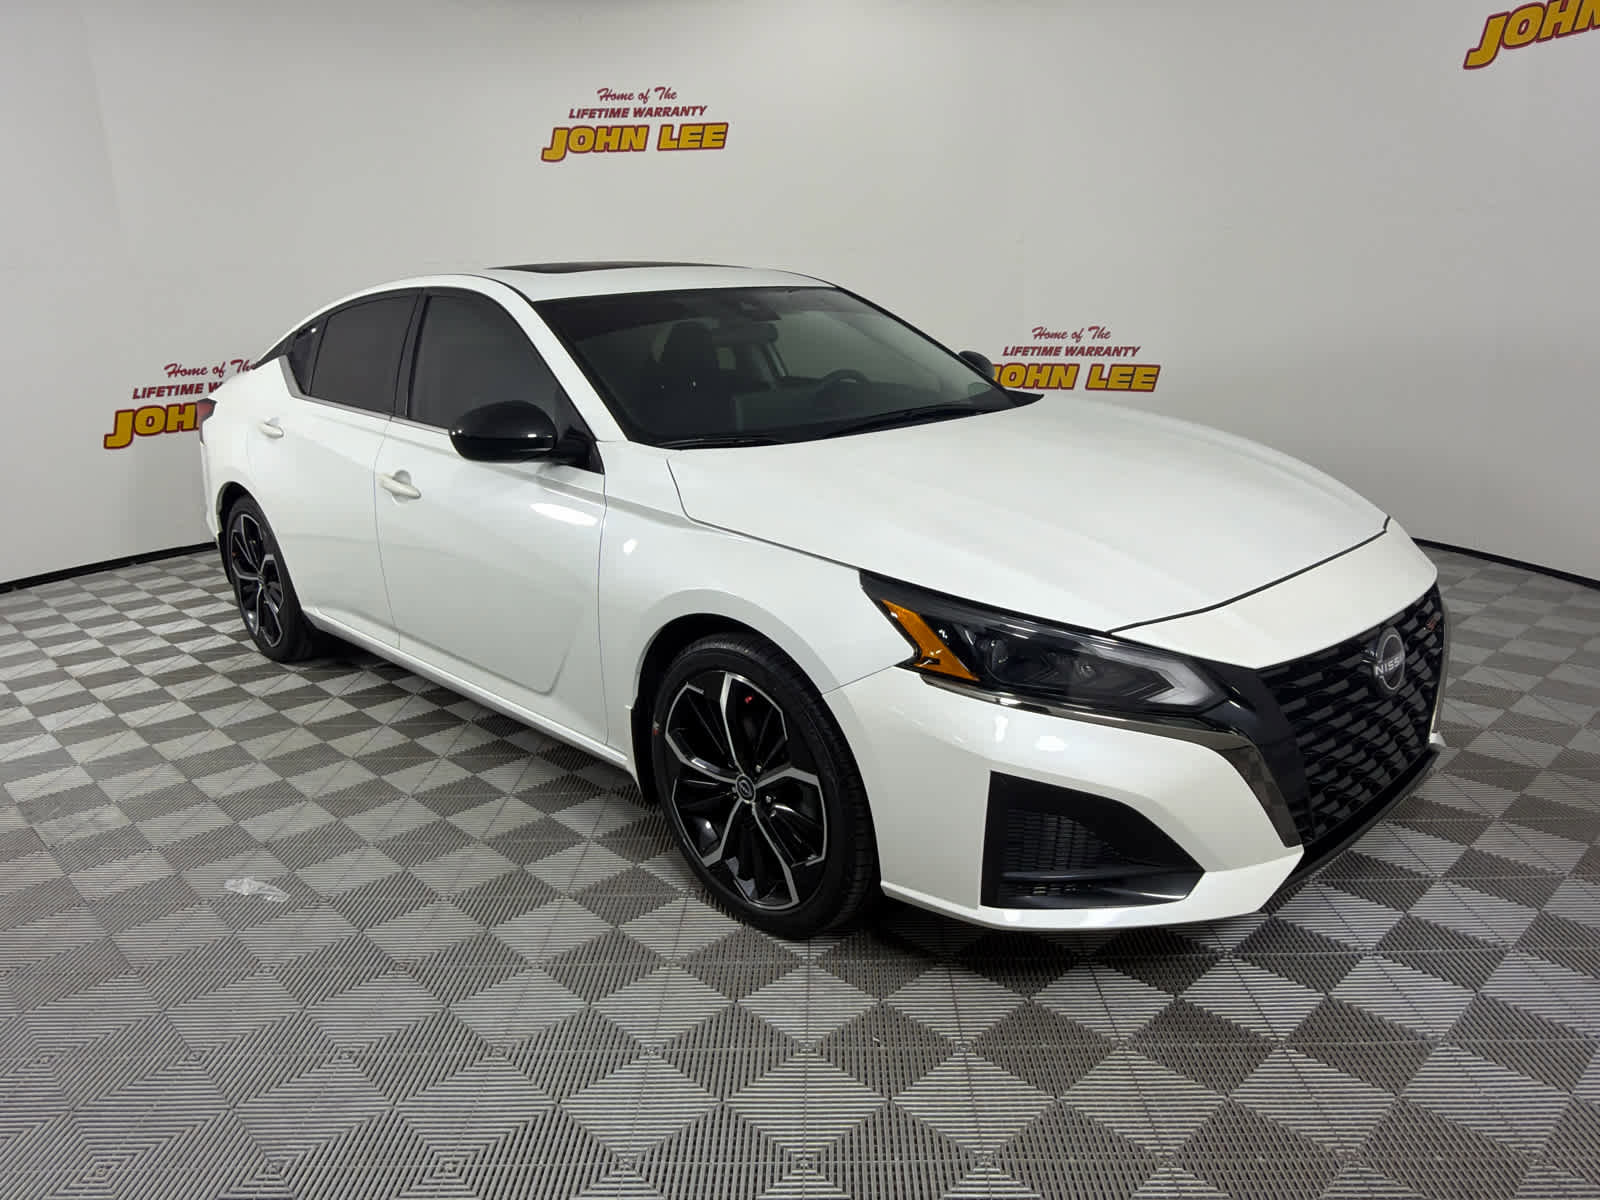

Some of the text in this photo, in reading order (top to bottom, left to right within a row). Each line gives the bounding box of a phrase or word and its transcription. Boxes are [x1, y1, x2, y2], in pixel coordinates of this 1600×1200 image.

[597, 86, 677, 104] Home of The
[568, 105, 708, 119] LIFETIME WARRANTY
[541, 122, 729, 162] JOHN LEE
[1031, 325, 1112, 343] Home of The
[1002, 345, 1141, 358] LIFETIME WARRANTY
[163, 362, 208, 378] Home
[212, 360, 226, 378] of
[1085, 363, 1161, 392] LEE
[132, 382, 205, 400] LIFETIME
[104, 402, 199, 449] JOH
[1374, 655, 1402, 677] NISS
